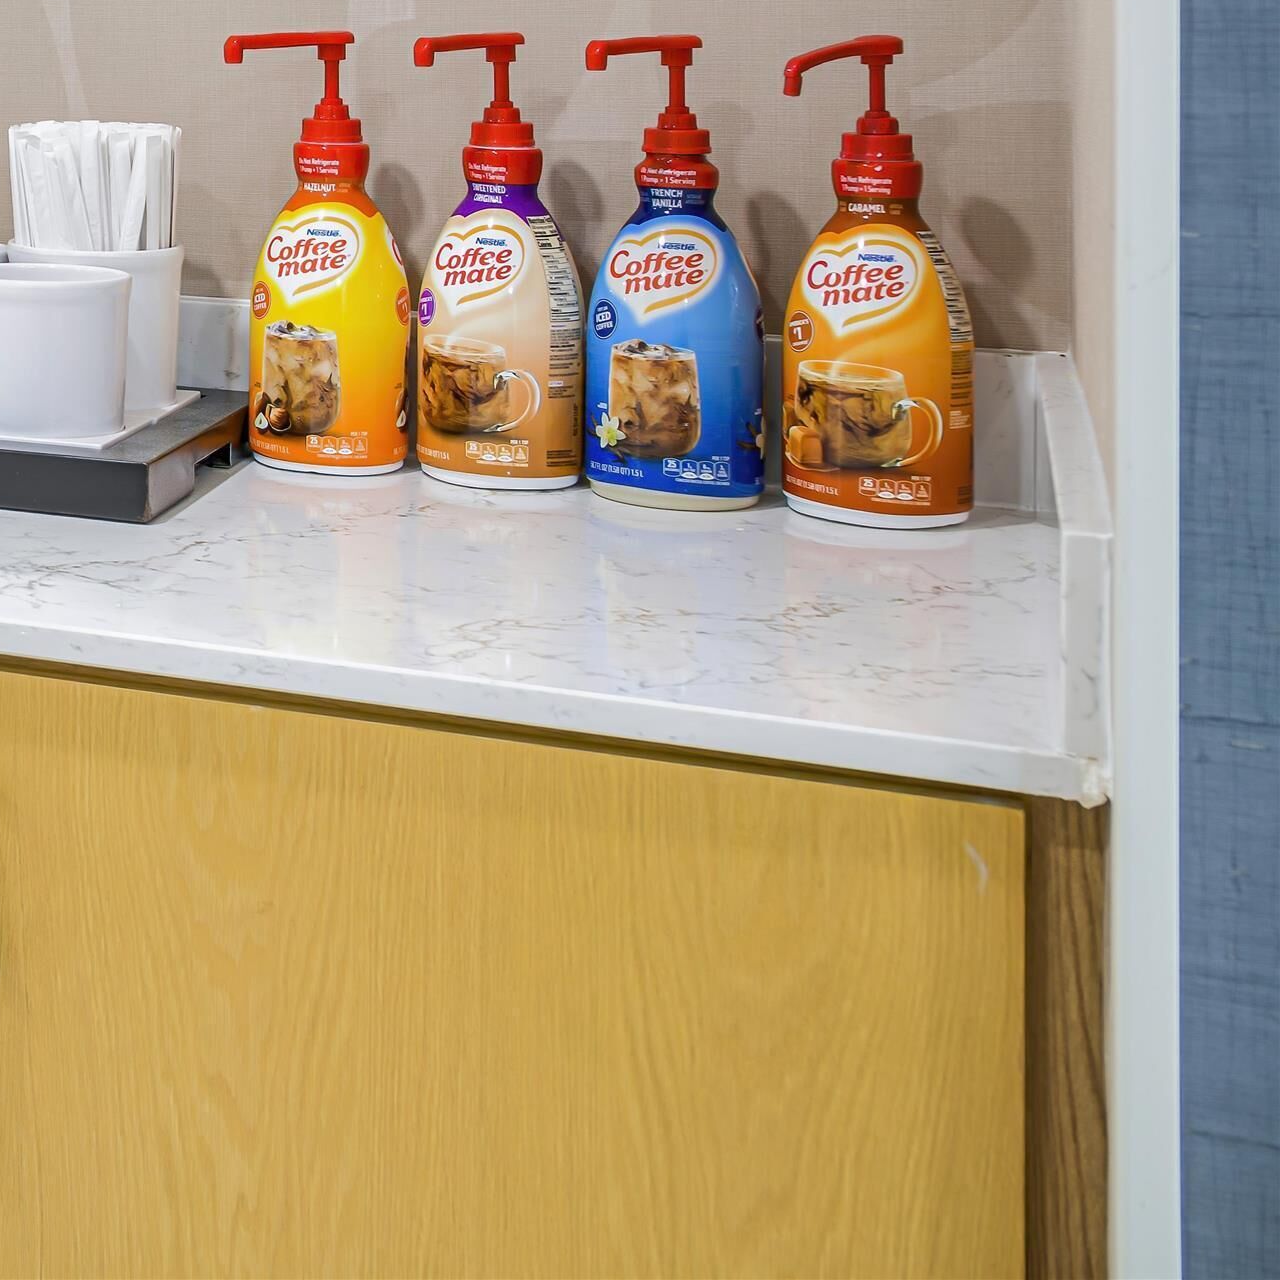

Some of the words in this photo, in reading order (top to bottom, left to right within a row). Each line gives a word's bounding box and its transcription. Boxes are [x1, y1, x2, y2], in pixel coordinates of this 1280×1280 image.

[303, 182, 336, 192] HAZELNUT
[472, 182, 506, 194] SWEETENED
[650, 188, 683, 198] FRENCH
[473, 193, 502, 204] ORIGINAL
[651, 198, 683, 208] VANILLA
[848, 203, 886, 214] CARAMEL
[267, 235, 348, 263] Coffee
[435, 242, 513, 270] Coffee
[278, 254, 347, 278] mate
[610, 250, 704, 279] Coffee
[444, 264, 512, 286] mate
[807, 260, 904, 289] Coffee
[625, 268, 704, 294] mate
[823, 281, 905, 306] mate
[596, 311, 611, 323] ICED
[596, 321, 613, 331] COFFEE
[310, 436, 318, 445] 25
[667, 459, 677, 468] 25
[863, 479, 873, 488] 25
